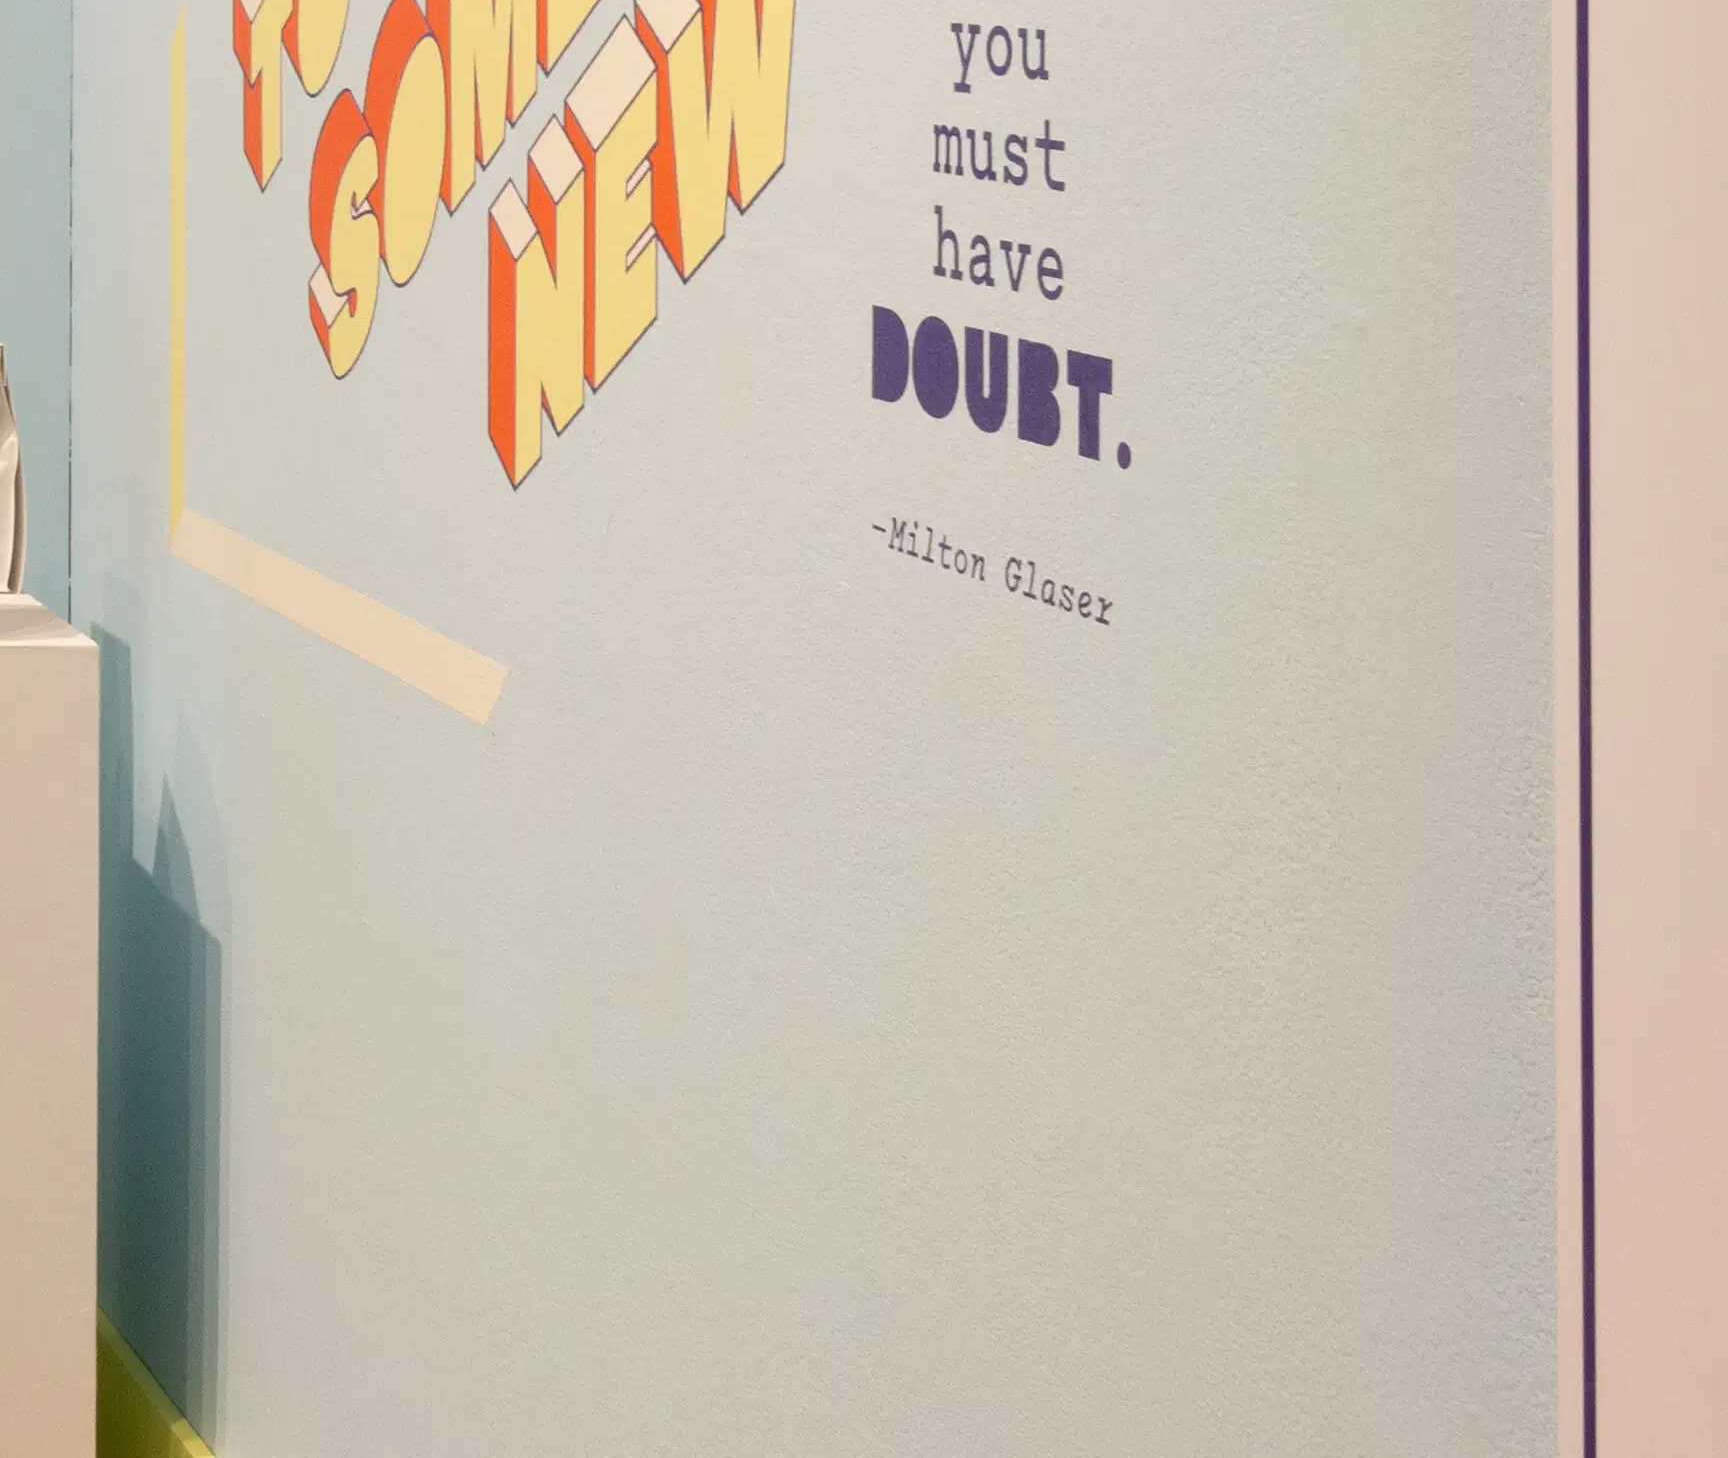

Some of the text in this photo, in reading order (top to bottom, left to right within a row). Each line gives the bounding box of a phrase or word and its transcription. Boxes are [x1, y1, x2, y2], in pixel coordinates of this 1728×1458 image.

[950, 21, 1050, 93] you
[932, 119, 1066, 192] must
[933, 204, 1065, 301] have
[872, 304, 1132, 470] DOUBT.
[1005, 557, 1113, 626] Glaser
